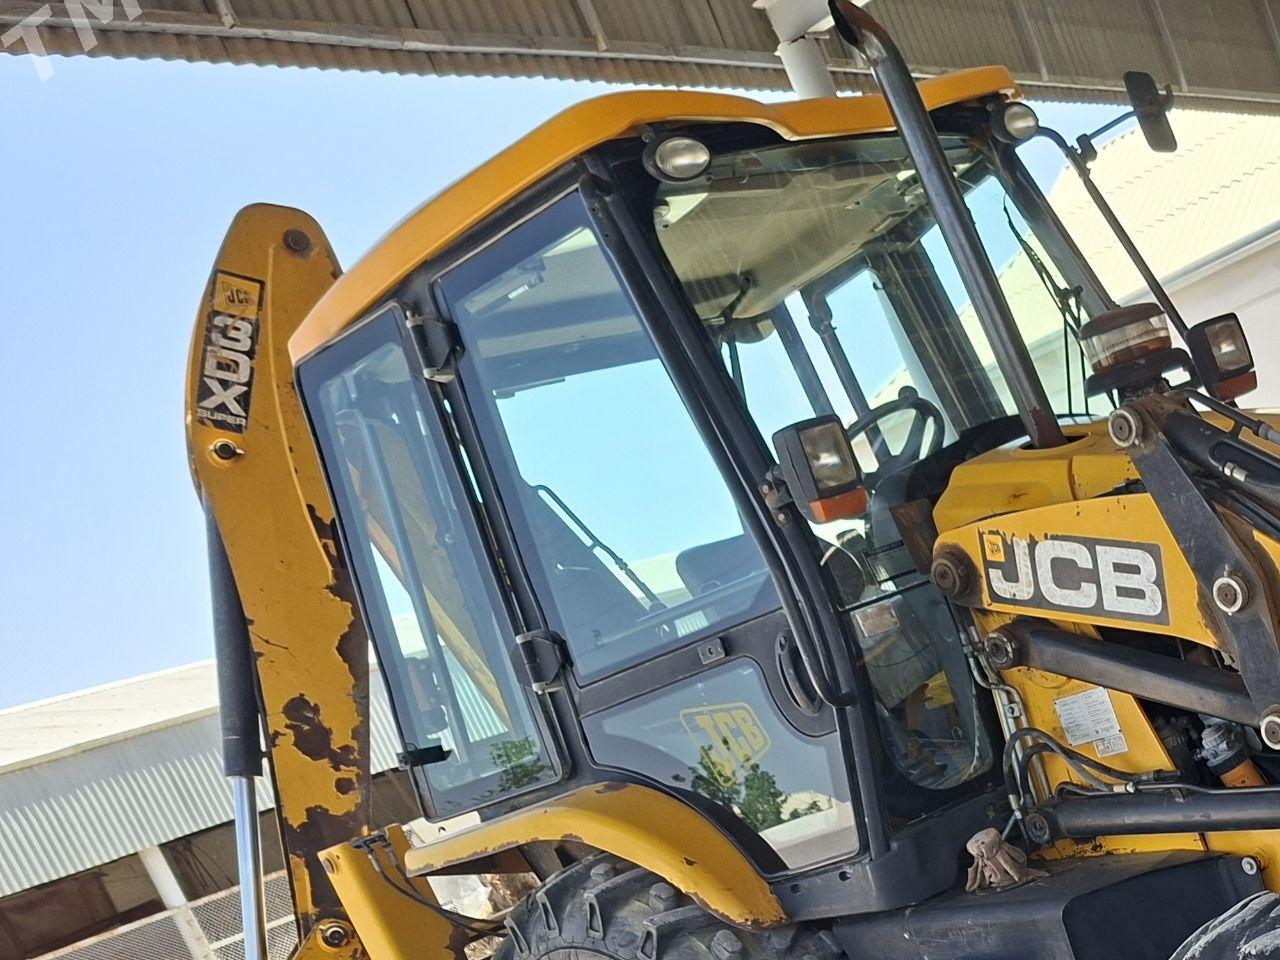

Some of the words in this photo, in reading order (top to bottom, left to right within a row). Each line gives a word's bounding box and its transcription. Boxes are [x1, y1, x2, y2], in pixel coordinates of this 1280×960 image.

[198, 410, 246, 427] SUPER
[989, 537, 1163, 616] JCB
[694, 709, 764, 777] JCB
